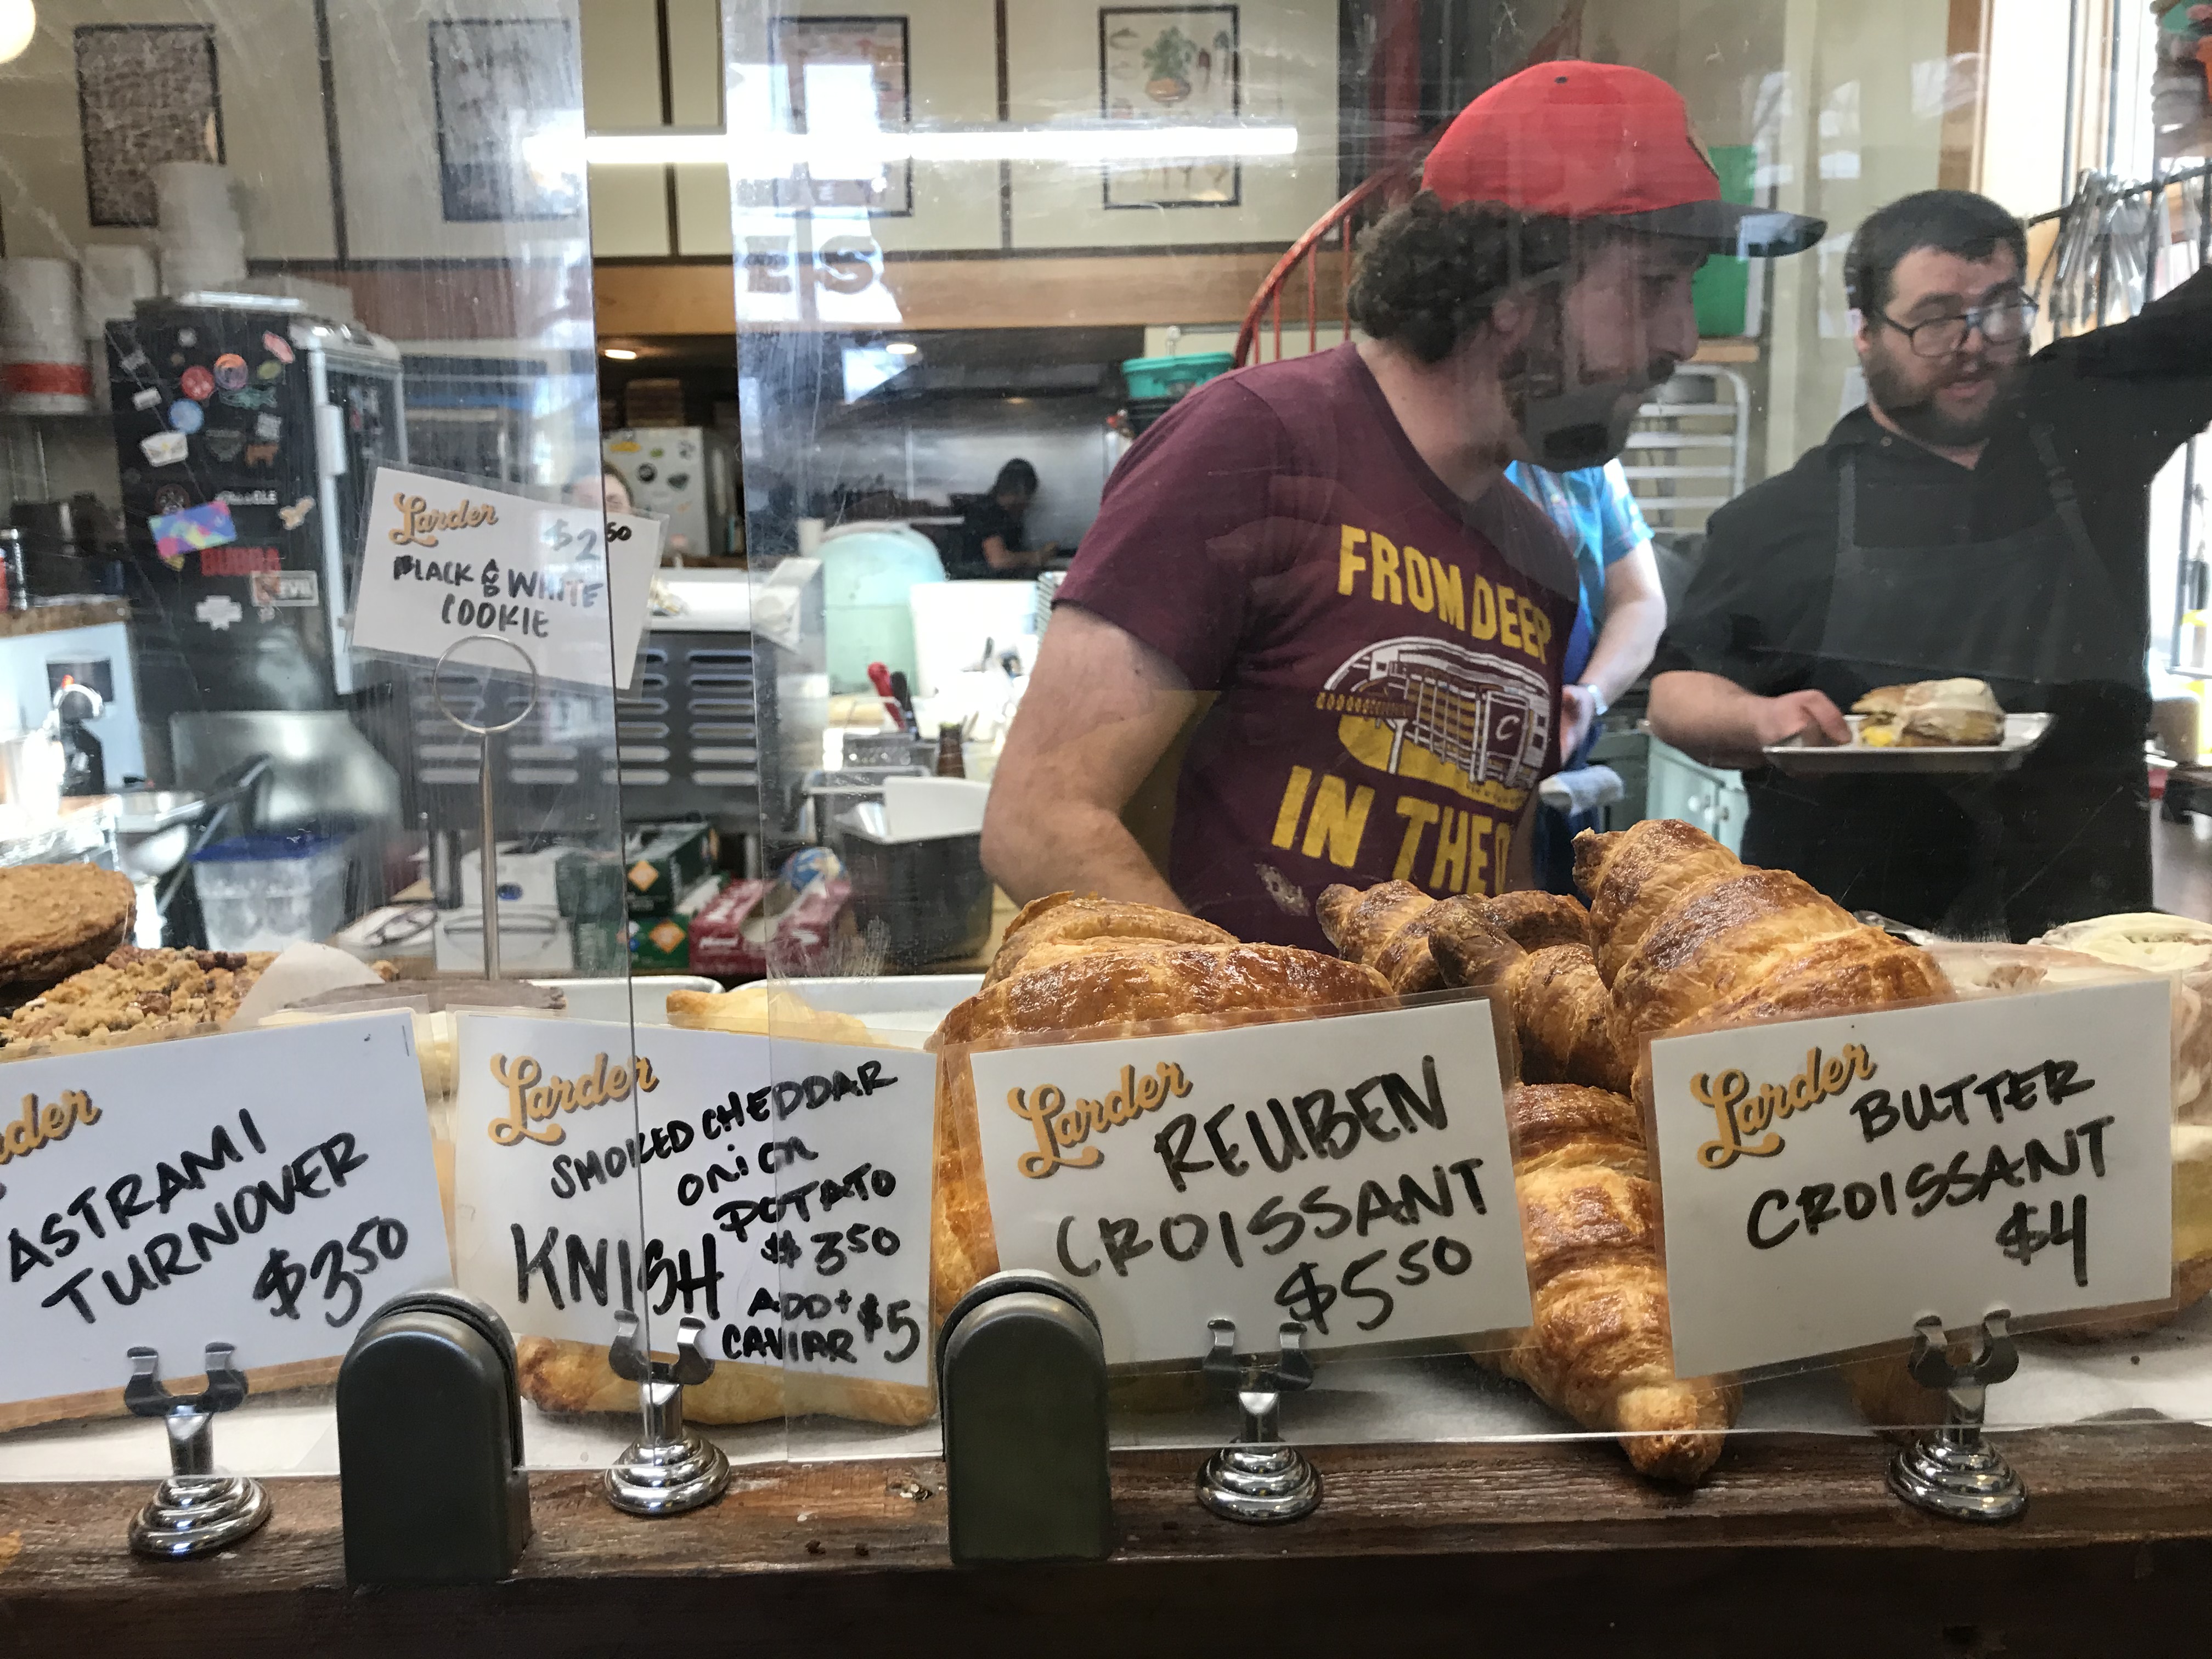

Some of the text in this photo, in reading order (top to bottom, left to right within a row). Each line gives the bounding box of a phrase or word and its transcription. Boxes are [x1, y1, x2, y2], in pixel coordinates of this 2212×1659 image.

[388, 492, 499, 548] Larder
[441, 592, 550, 638] COOKIE
[1338, 524, 1552, 665] FROM DEEP
[1271, 766, 1375, 870] IN
[488, 1052, 660, 1146] Larder
[551, 1060, 899, 1199] SMOKED CHEDDAR
[1007, 1060, 1193, 1179] Larder
[1153, 1055, 1449, 1193] REUBEN
[1689, 1042, 1877, 1170] Larder
[1849, 1058, 2095, 1143] BUTTER
[8, 1108, 267, 1283] ASTRAMI
[41, 1132, 369, 1324] TURNOVER
[713, 1162, 897, 1243] POTATO
[1056, 1158, 1489, 1277] CROISSANT
[1747, 1116, 2115, 1251] CROISSANT
[510, 1222, 724, 1321] KNISH
[1995, 1193, 2089, 1288] $4
[722, 1293, 921, 1364] CAVIAR $5
